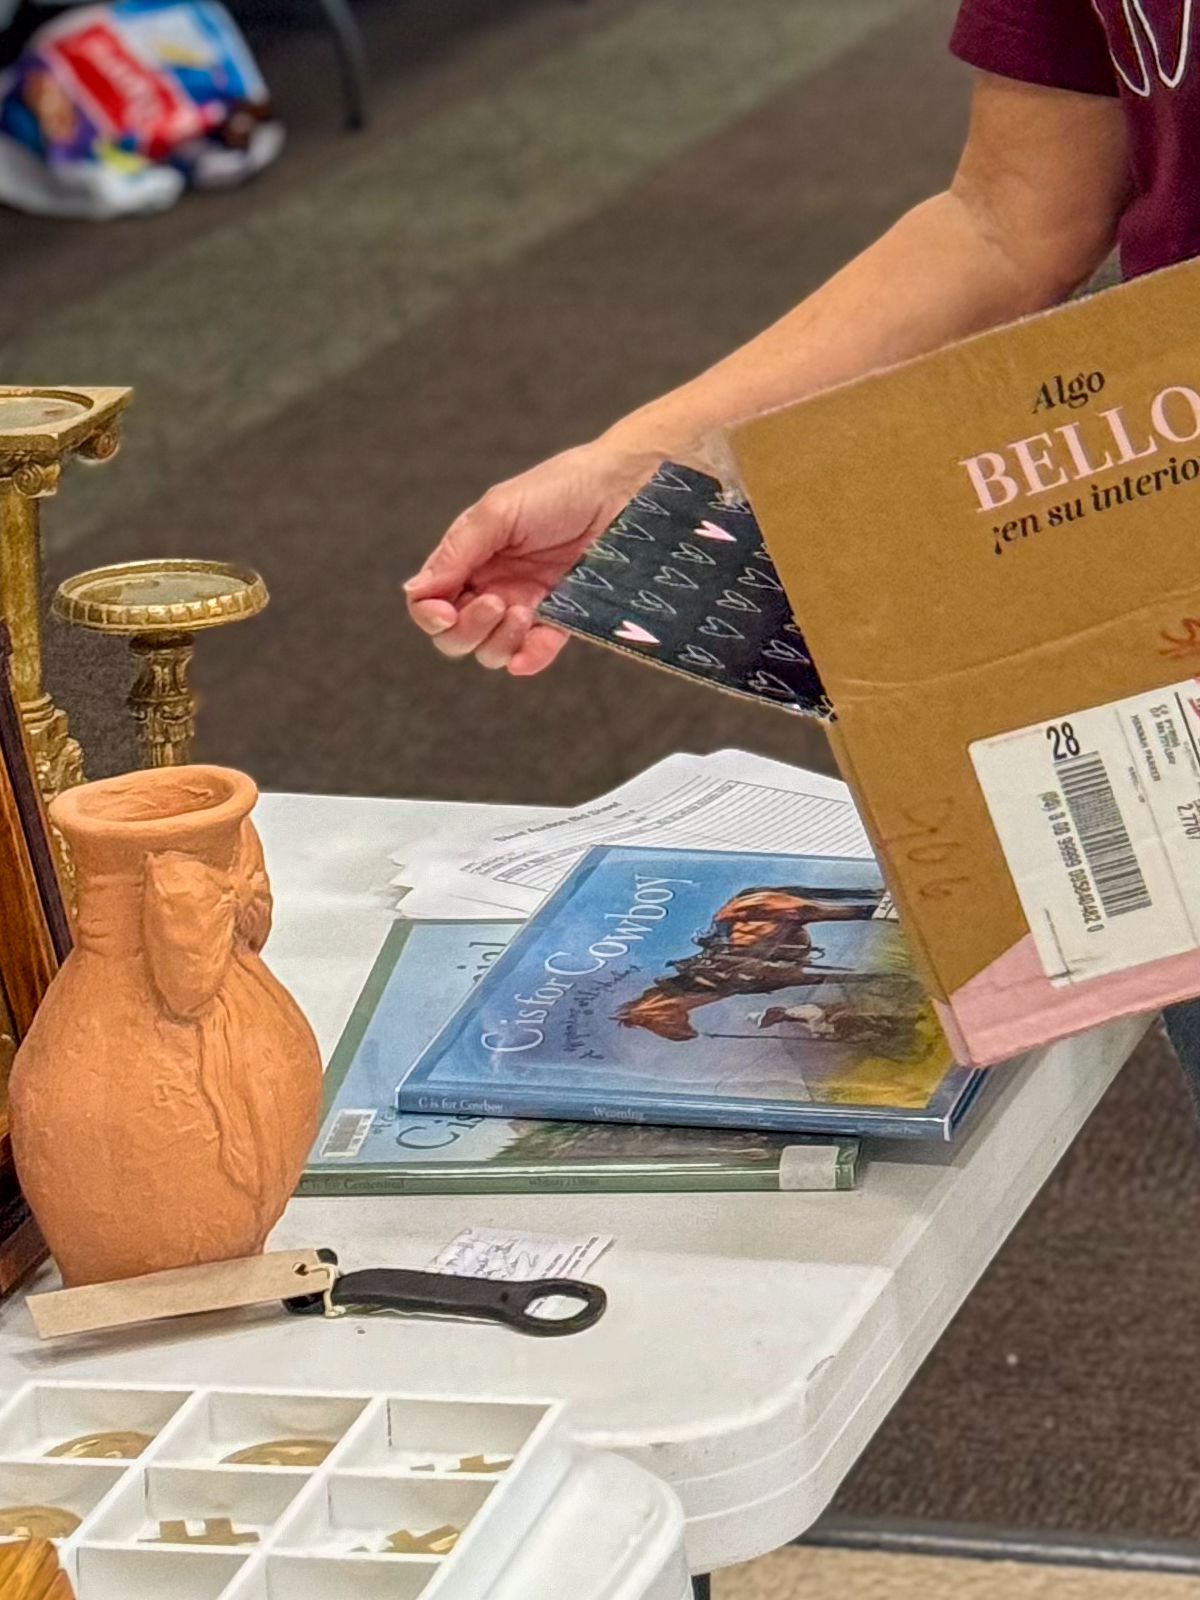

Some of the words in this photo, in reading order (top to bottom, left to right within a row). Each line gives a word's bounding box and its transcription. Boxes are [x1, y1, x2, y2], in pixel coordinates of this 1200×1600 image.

[1030, 370, 1106, 415] Algo
[1047, 498, 1085, 528] su
[1044, 722, 1082, 761] 28
[480, 1030, 545, 1052] C
[514, 975, 574, 1006] for
[544, 873, 694, 976] Cowboy
